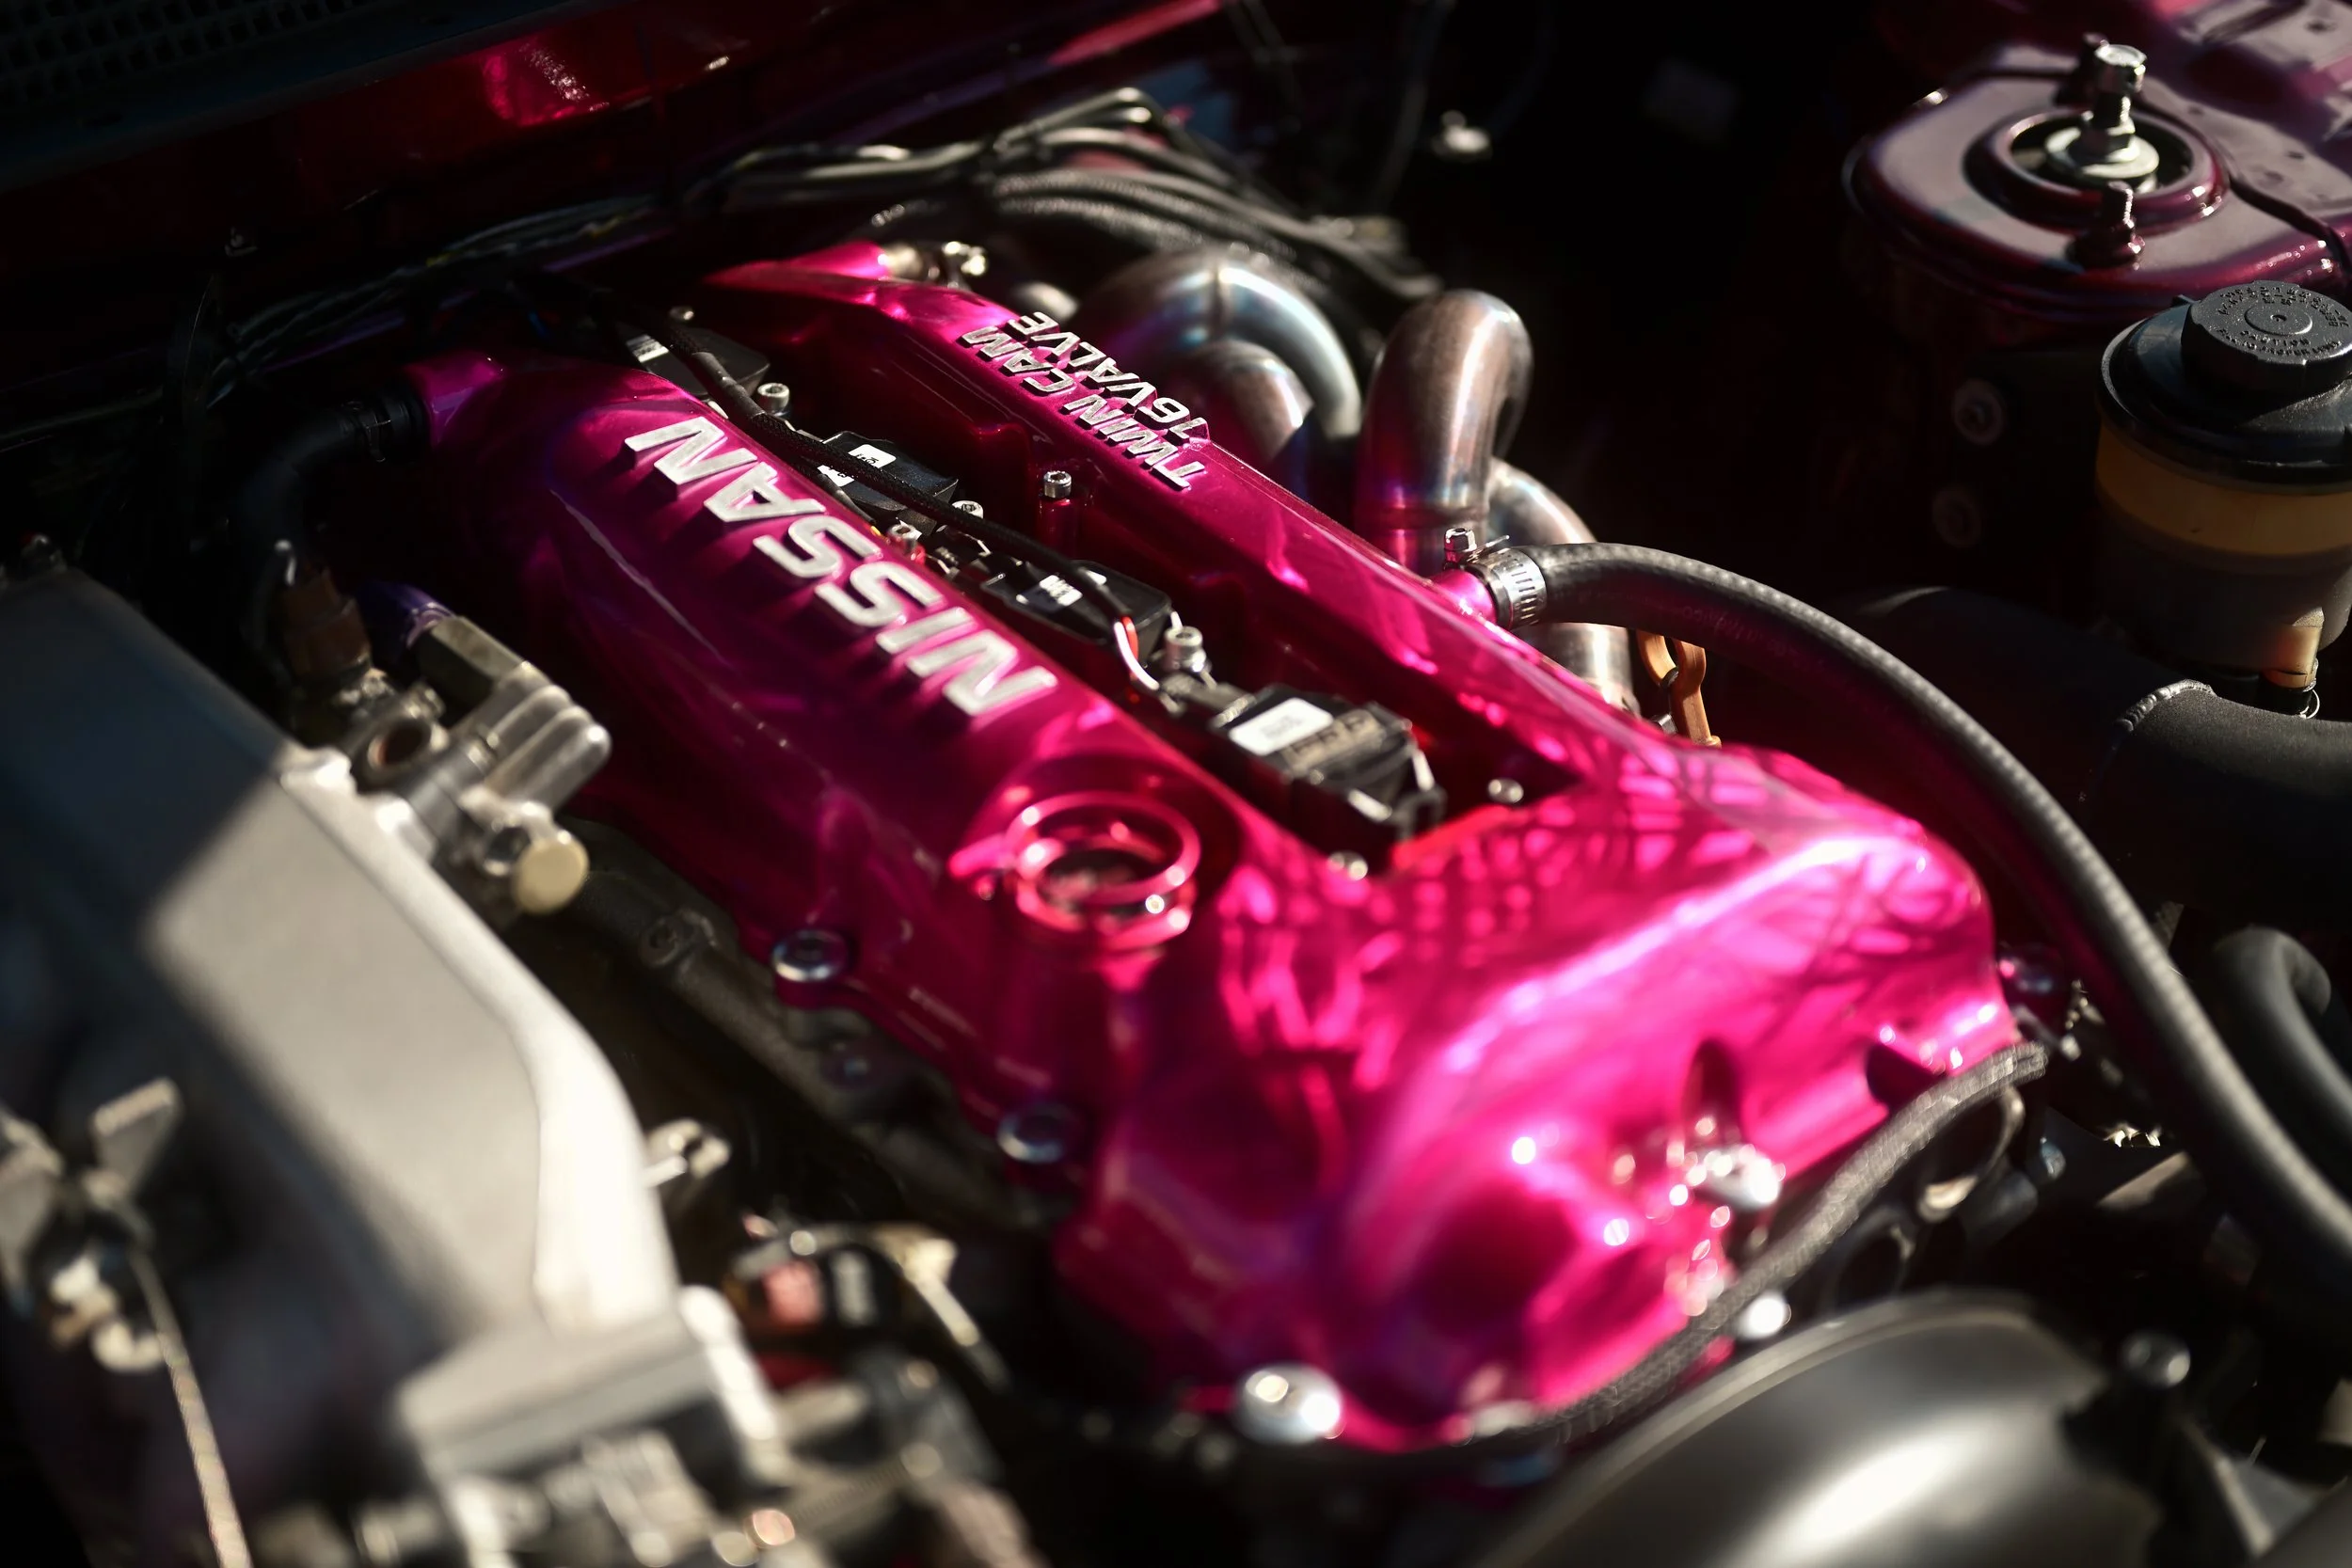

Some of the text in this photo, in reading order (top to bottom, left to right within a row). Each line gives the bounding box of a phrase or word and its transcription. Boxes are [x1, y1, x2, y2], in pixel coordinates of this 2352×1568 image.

[961, 325, 1205, 489] TWIN CAM
[1009, 311, 1209, 439] 16VALVE
[624, 416, 1058, 716] NISSAN
